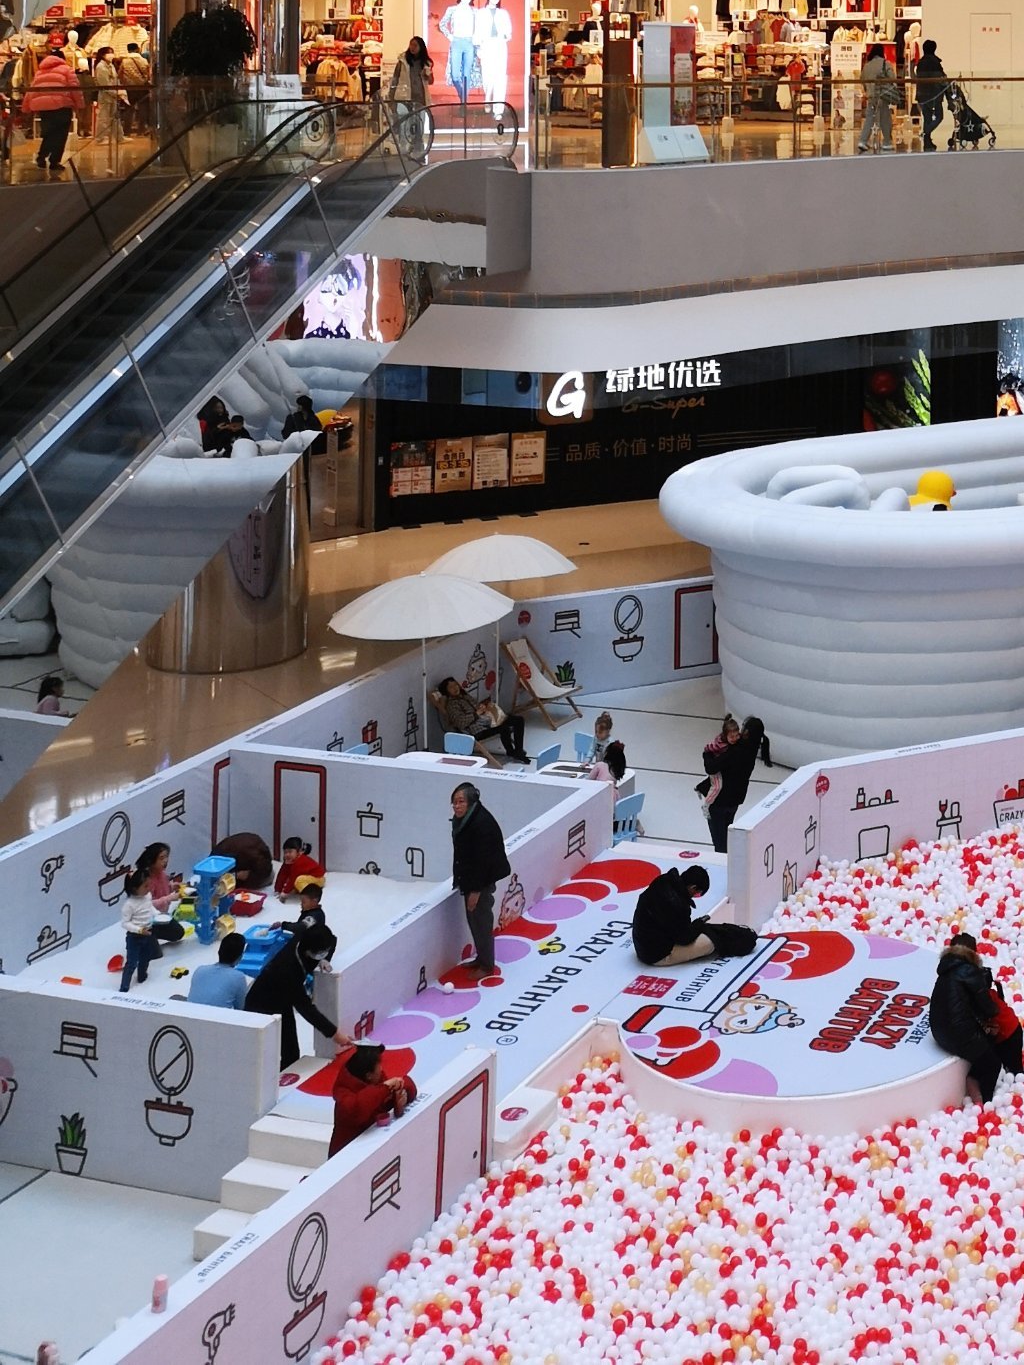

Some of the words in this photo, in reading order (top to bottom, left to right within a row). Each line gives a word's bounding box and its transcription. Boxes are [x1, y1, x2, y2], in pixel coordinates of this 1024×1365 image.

[546, 370, 586, 419] G
[605, 359, 722, 393] 绿地优选
[621, 394, 706, 419] G-Super
[999, 809, 1024, 822] CRAZY
[568, 920, 633, 963] CRAZY
[485, 965, 583, 1032] BATHTUB
[674, 967, 720, 1003] BATHTUB
[809, 978, 900, 1053] BATHTUB
[860, 993, 930, 1049] CRAZY
